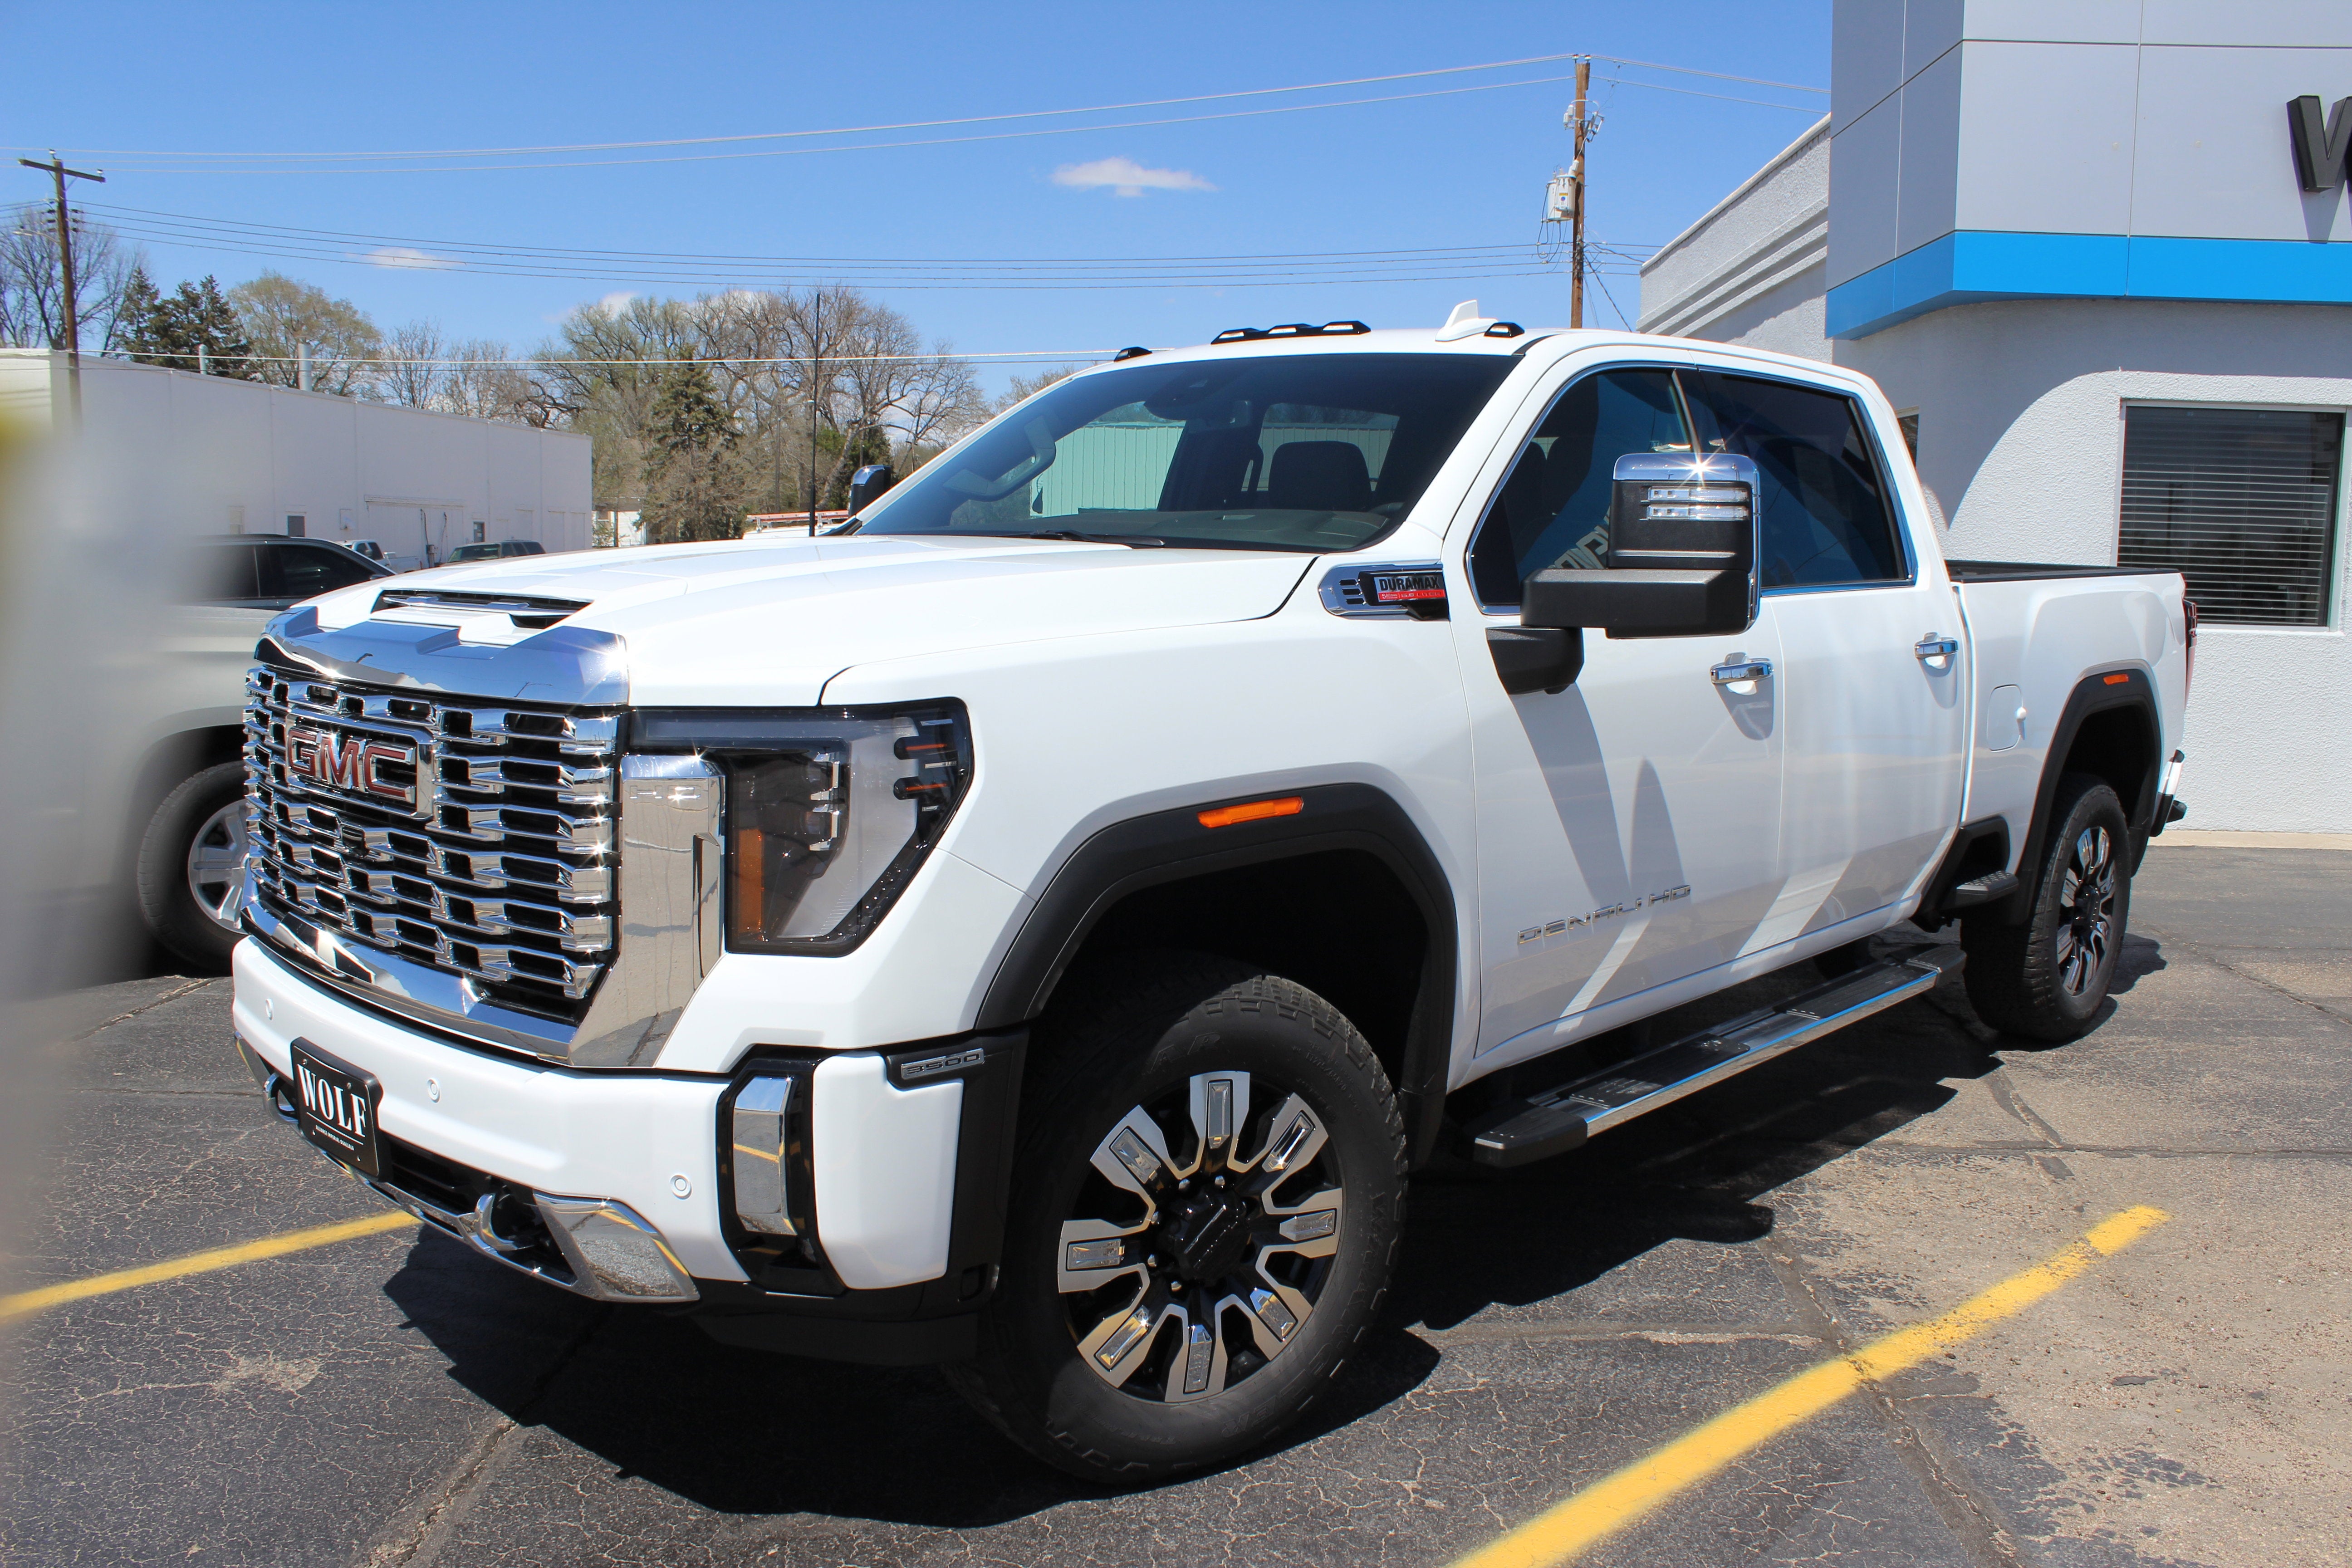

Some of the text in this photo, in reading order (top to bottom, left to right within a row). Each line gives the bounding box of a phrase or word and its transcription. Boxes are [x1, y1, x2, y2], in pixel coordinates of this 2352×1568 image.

[1378, 576, 1441, 591] DURAMAX
[288, 727, 415, 803] GMC
[1517, 884, 1691, 945] DENALI HD
[296, 1063, 367, 1137] WOLF
